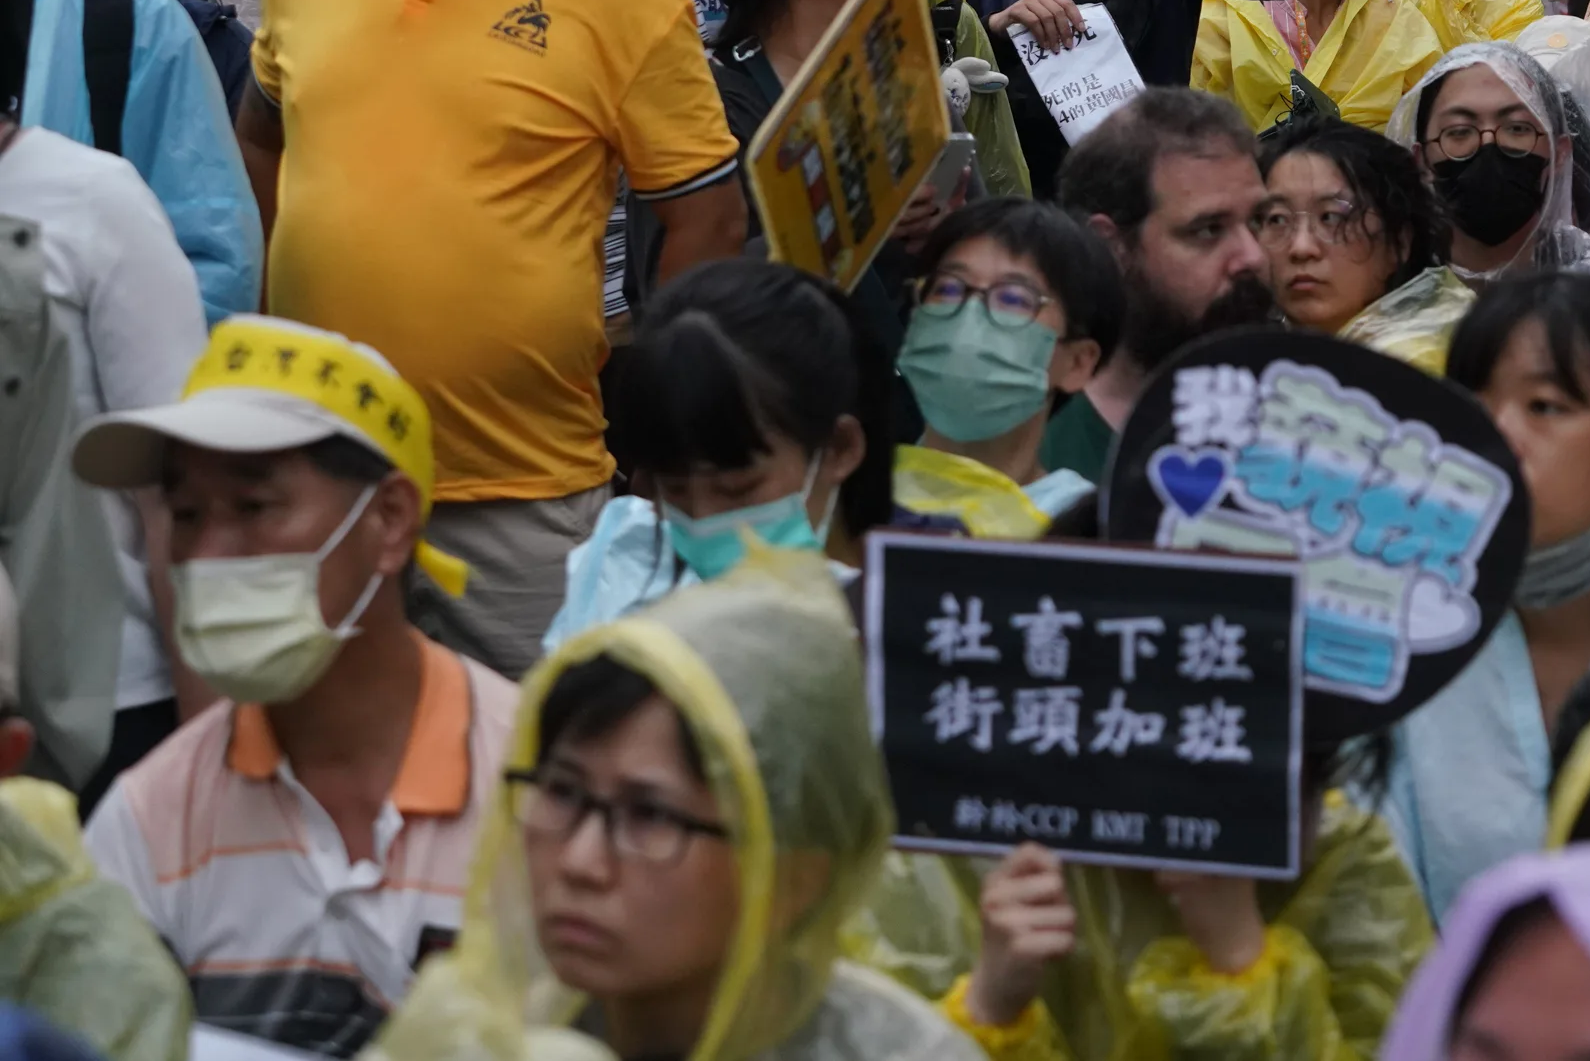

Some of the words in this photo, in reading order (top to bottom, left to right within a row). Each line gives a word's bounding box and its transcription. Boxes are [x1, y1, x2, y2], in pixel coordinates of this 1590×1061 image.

[925, 591, 1254, 684] 社畜下班
[923, 675, 1254, 764] 街頭加班
